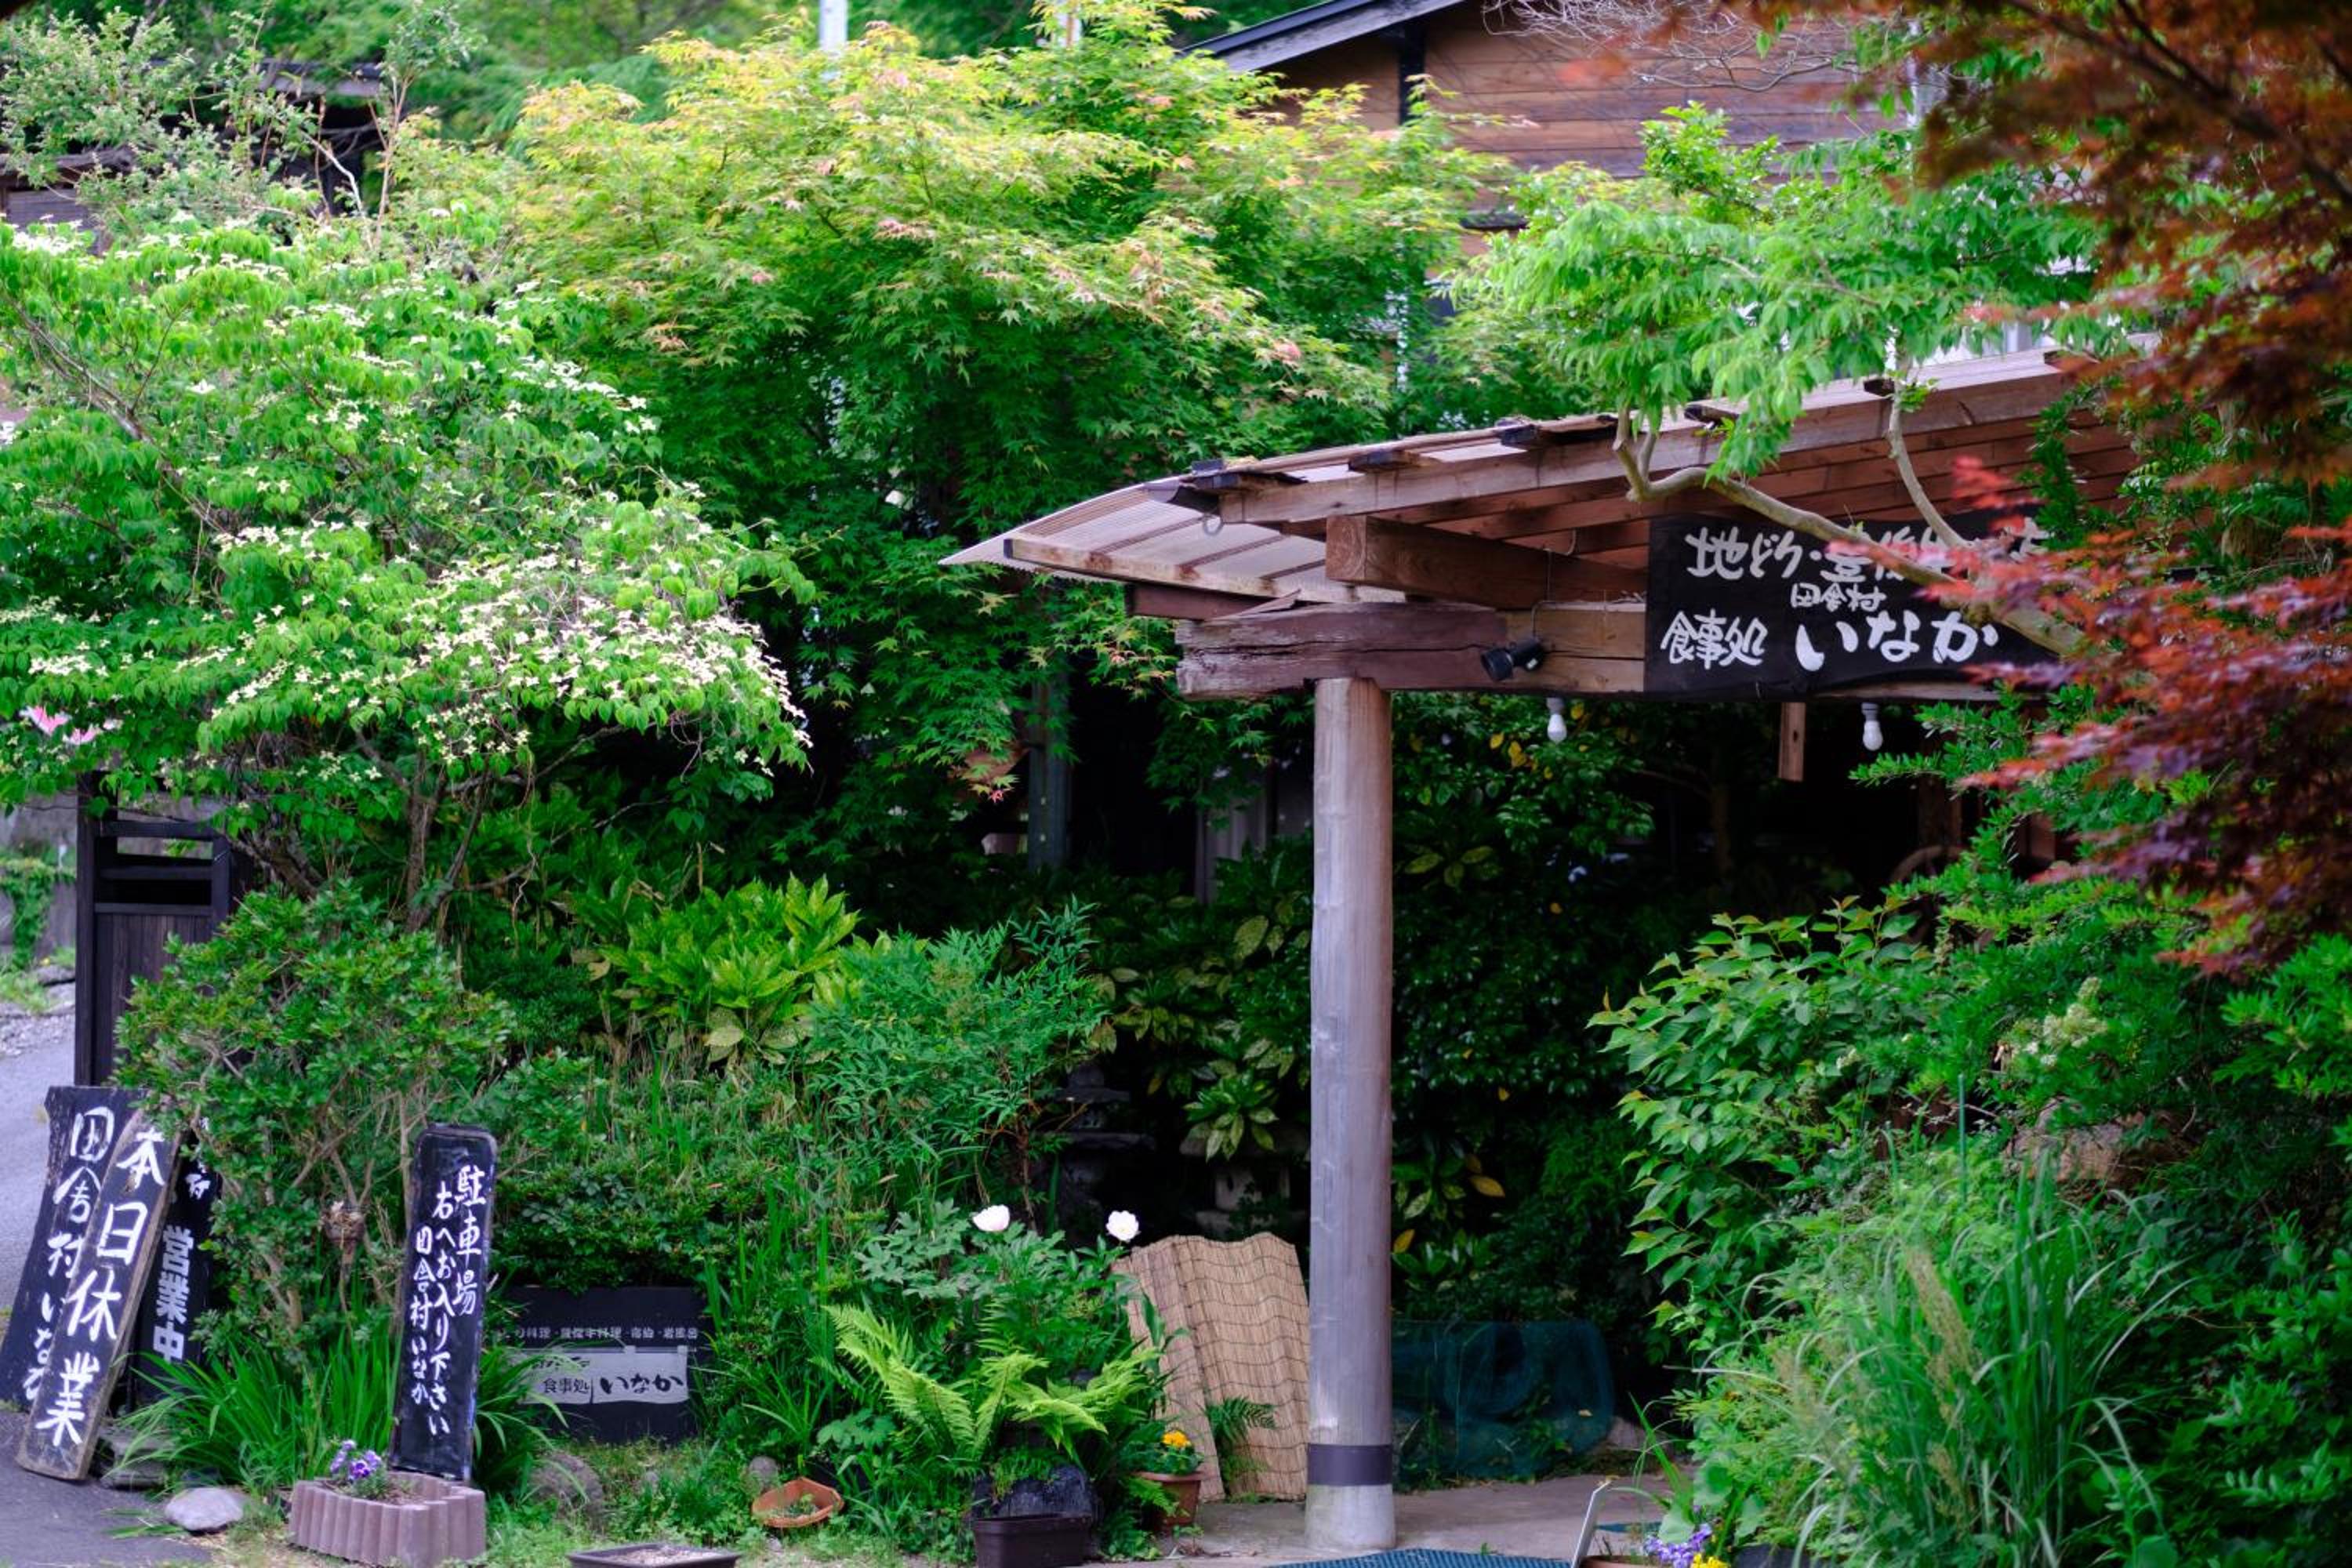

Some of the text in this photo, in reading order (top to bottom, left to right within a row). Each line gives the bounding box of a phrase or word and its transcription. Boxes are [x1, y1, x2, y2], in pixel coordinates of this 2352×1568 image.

[1661, 609, 1998, 672] 食事処 いなか
[35, 1128, 165, 1446] 本日休業
[153, 1225, 194, 1363] 営業中
[452, 1165, 486, 1316] 駐車場
[543, 1373, 684, 1395] 食事処 いなか
